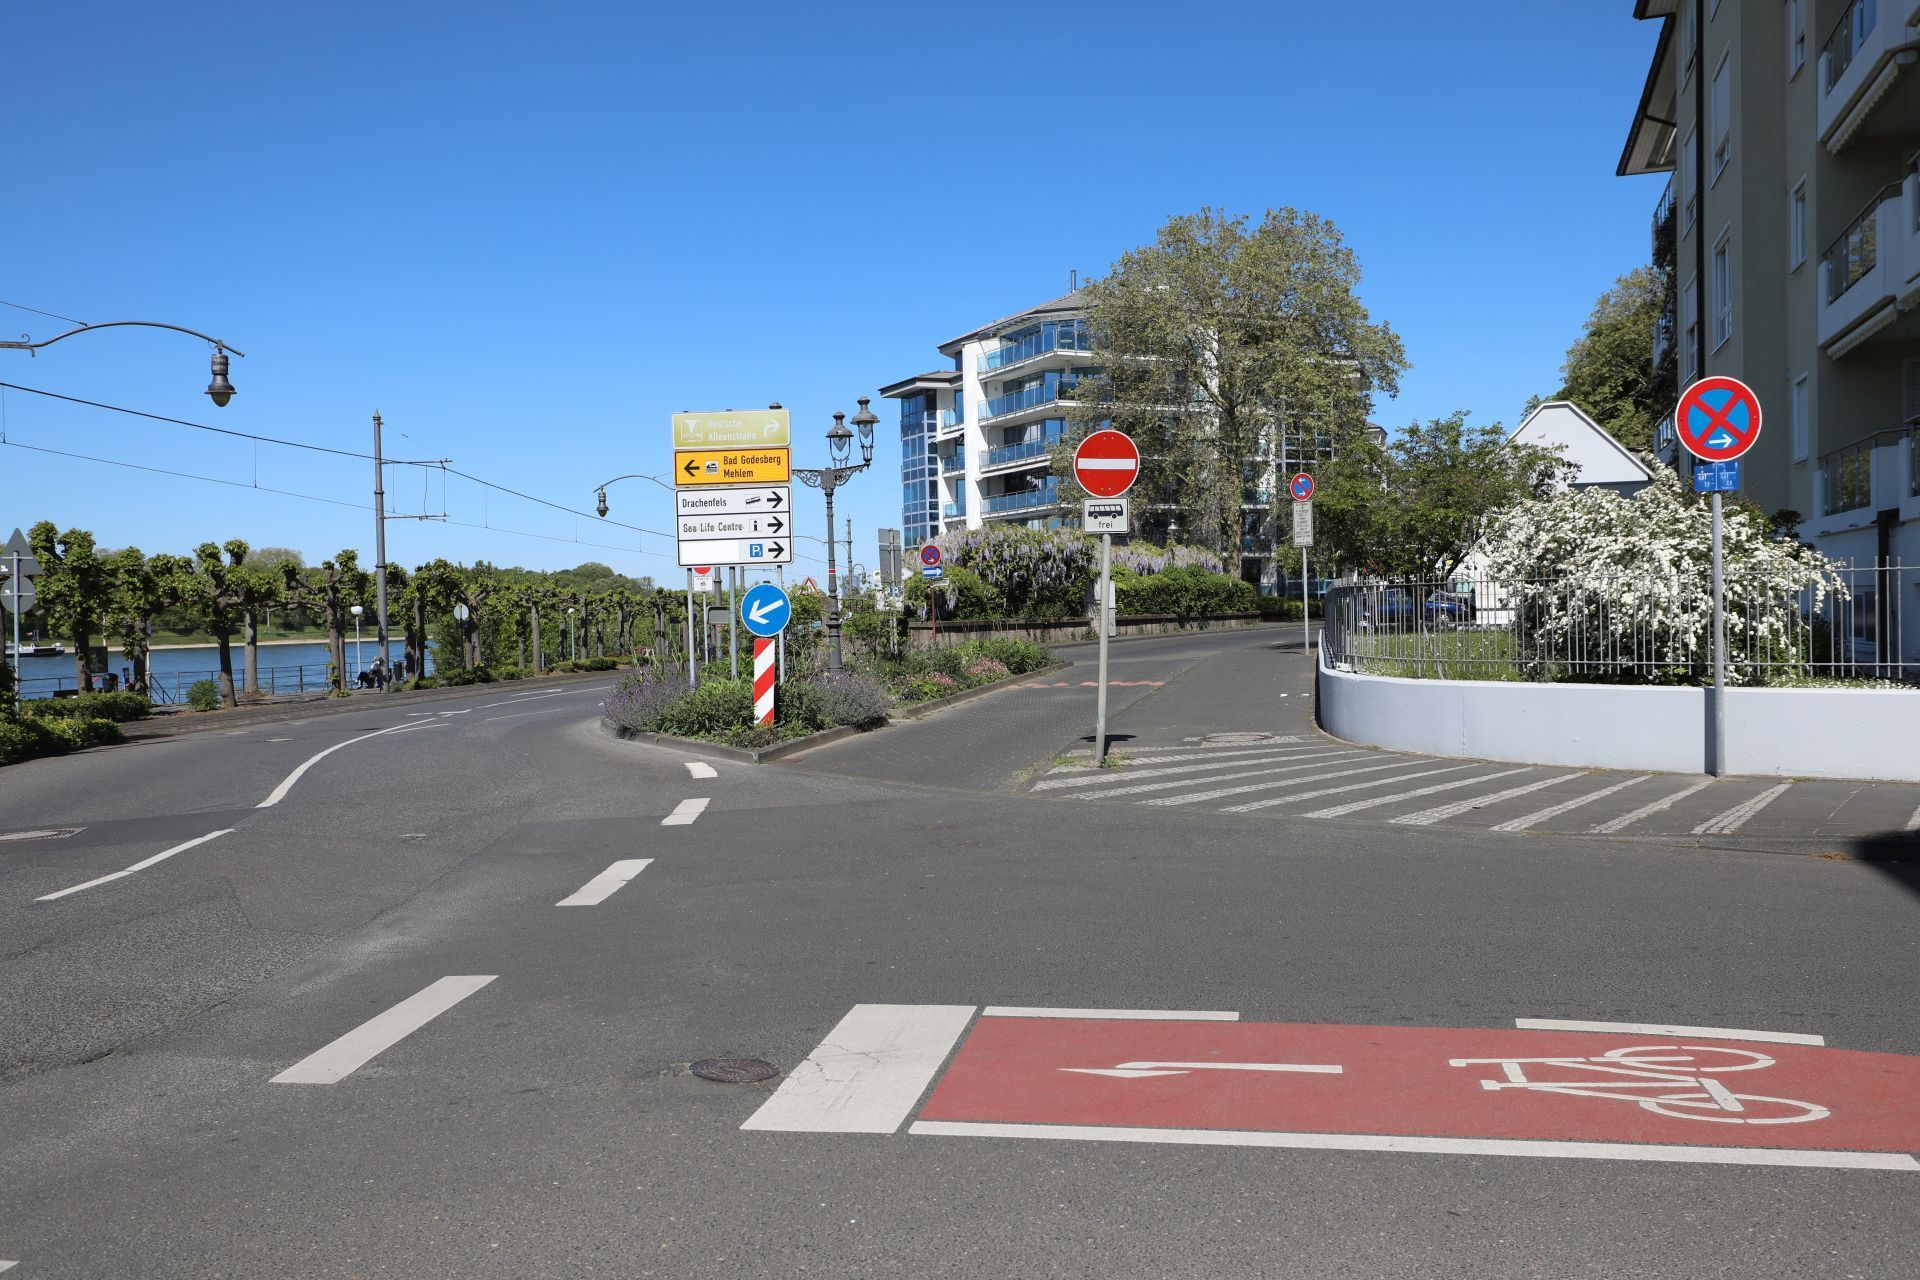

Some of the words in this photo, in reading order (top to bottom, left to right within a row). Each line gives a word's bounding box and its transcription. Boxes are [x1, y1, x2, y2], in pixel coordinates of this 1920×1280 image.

[723, 456, 738, 465] Bad
[740, 455, 781, 466] Godesberg
[723, 468, 754, 478] Mehlem
[682, 498, 727, 508] Drachenfels
[683, 523, 697, 533] Sea
[700, 522, 715, 532] Life
[718, 522, 743, 531] Centre
